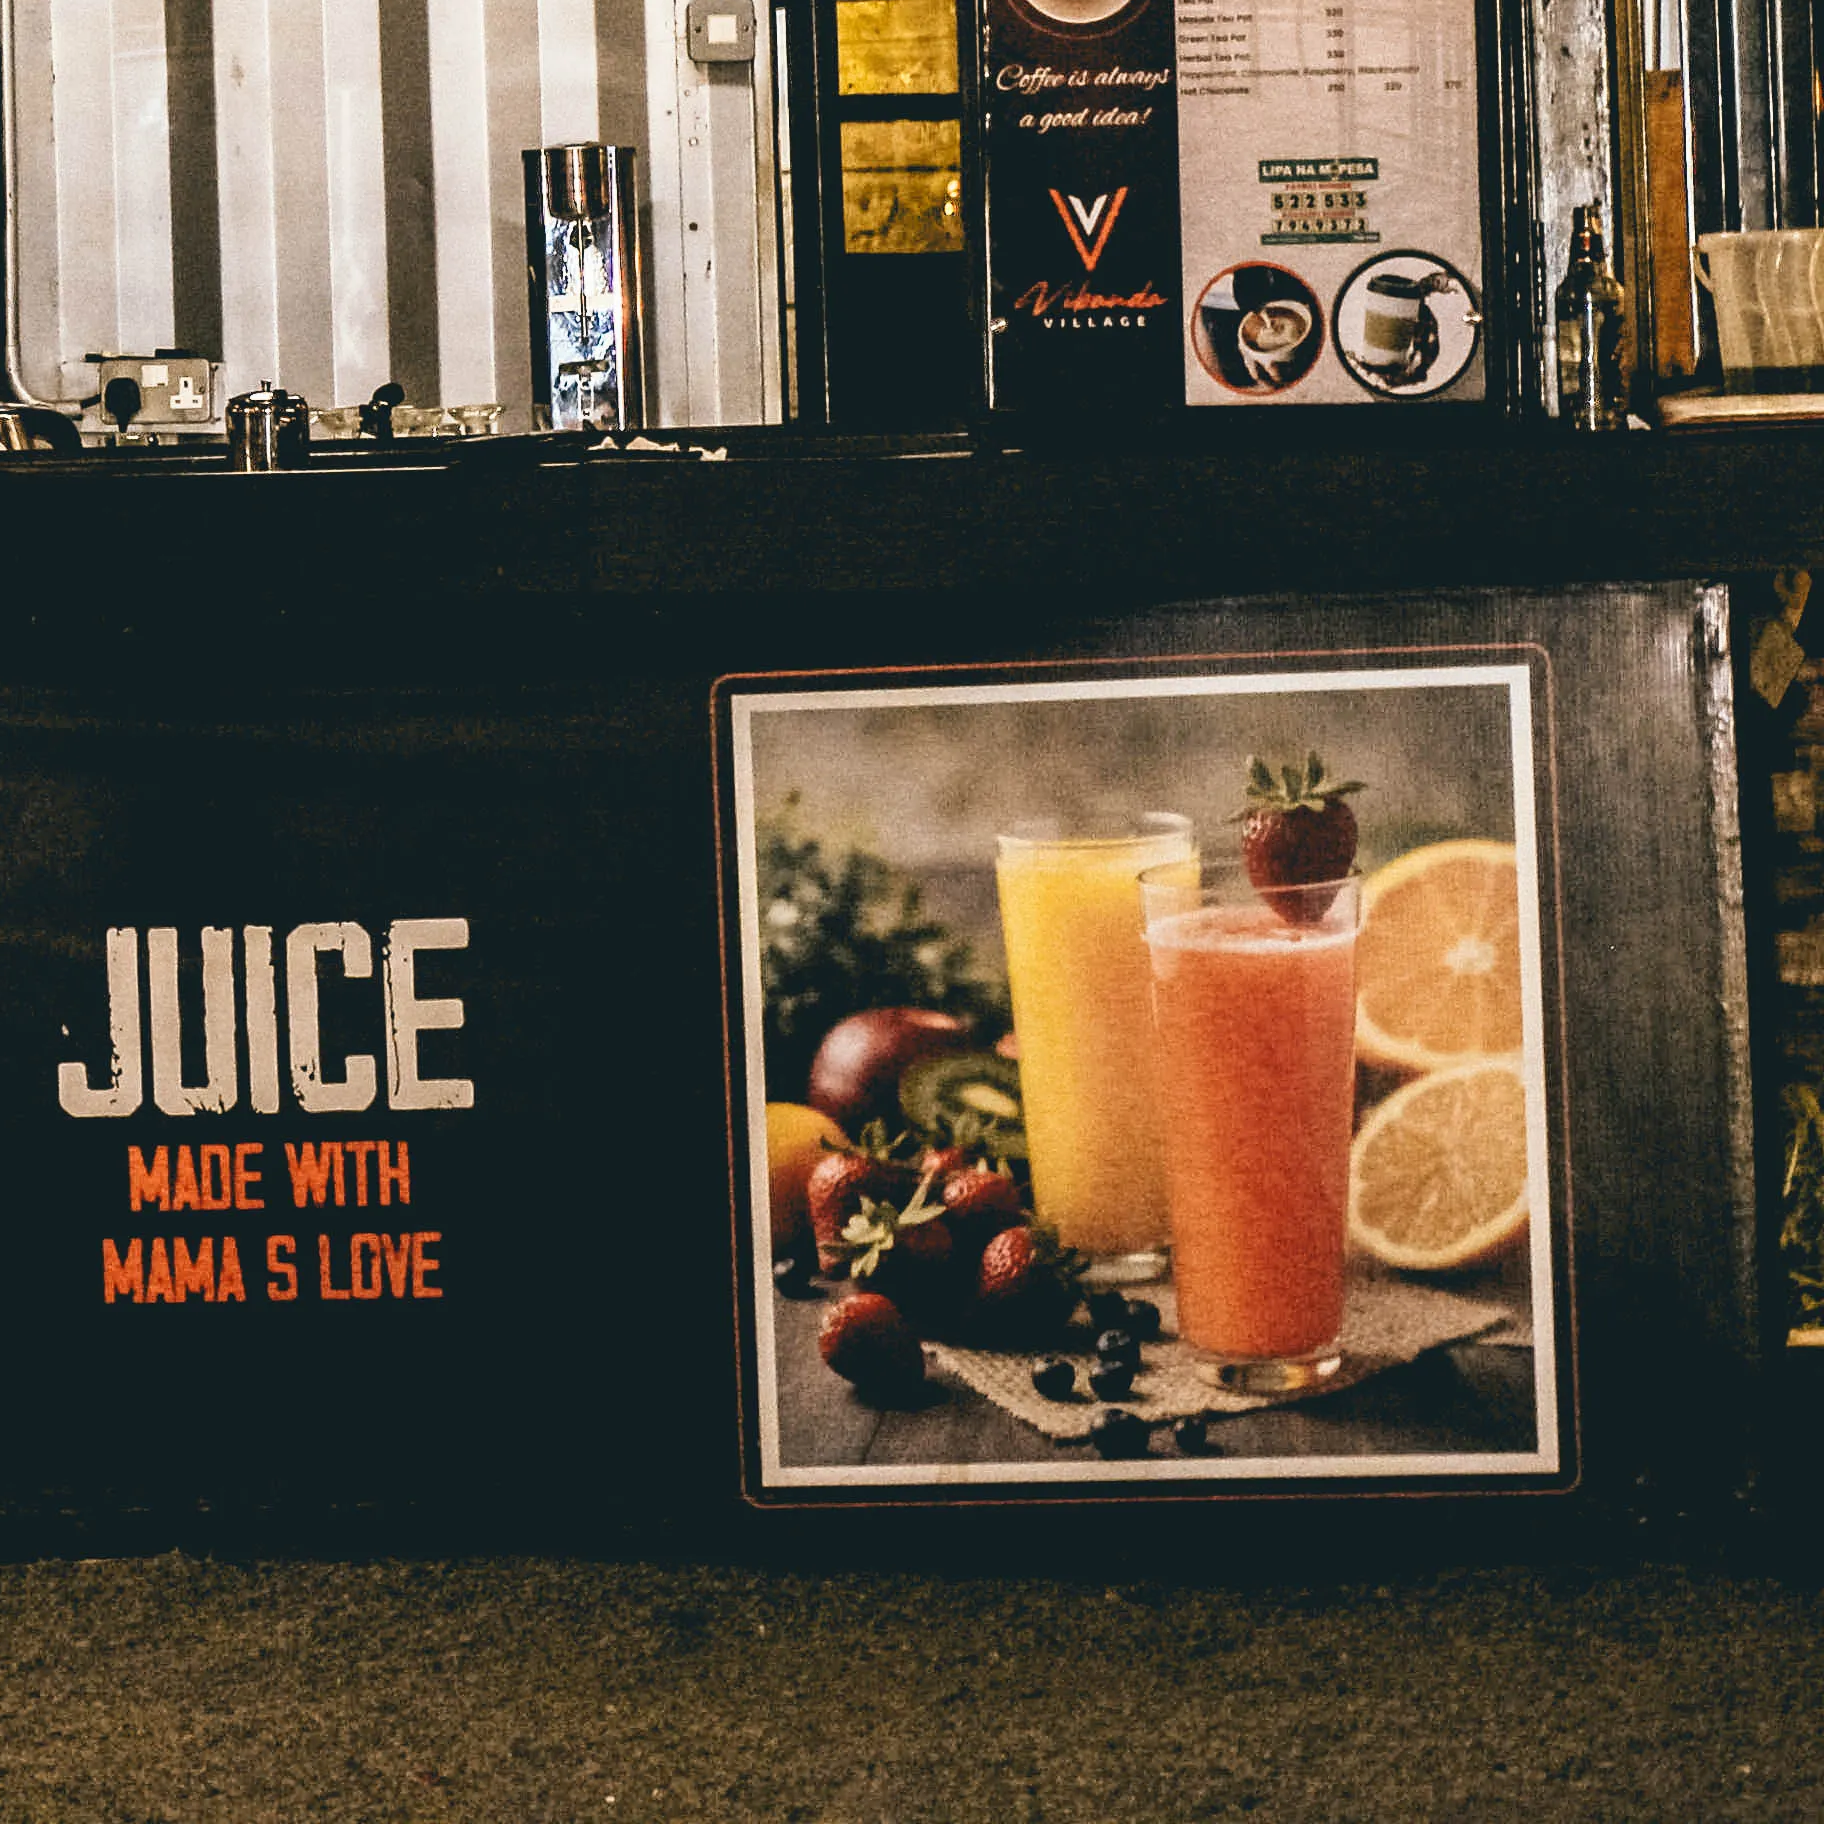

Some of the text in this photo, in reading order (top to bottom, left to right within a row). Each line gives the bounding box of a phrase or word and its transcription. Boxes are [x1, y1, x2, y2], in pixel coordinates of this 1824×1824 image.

[995, 63, 1171, 95] Coffee is always
[1019, 106, 1153, 134] a good idea!
[1261, 165, 1292, 177] LIPA
[1295, 164, 1316, 175] NA
[1043, 316, 1147, 329] VILLAGE
[57, 917, 475, 1118] JUICE
[127, 1140, 411, 1212] MADE WITH
[101, 1231, 443, 1304] MAMA S LOVE
